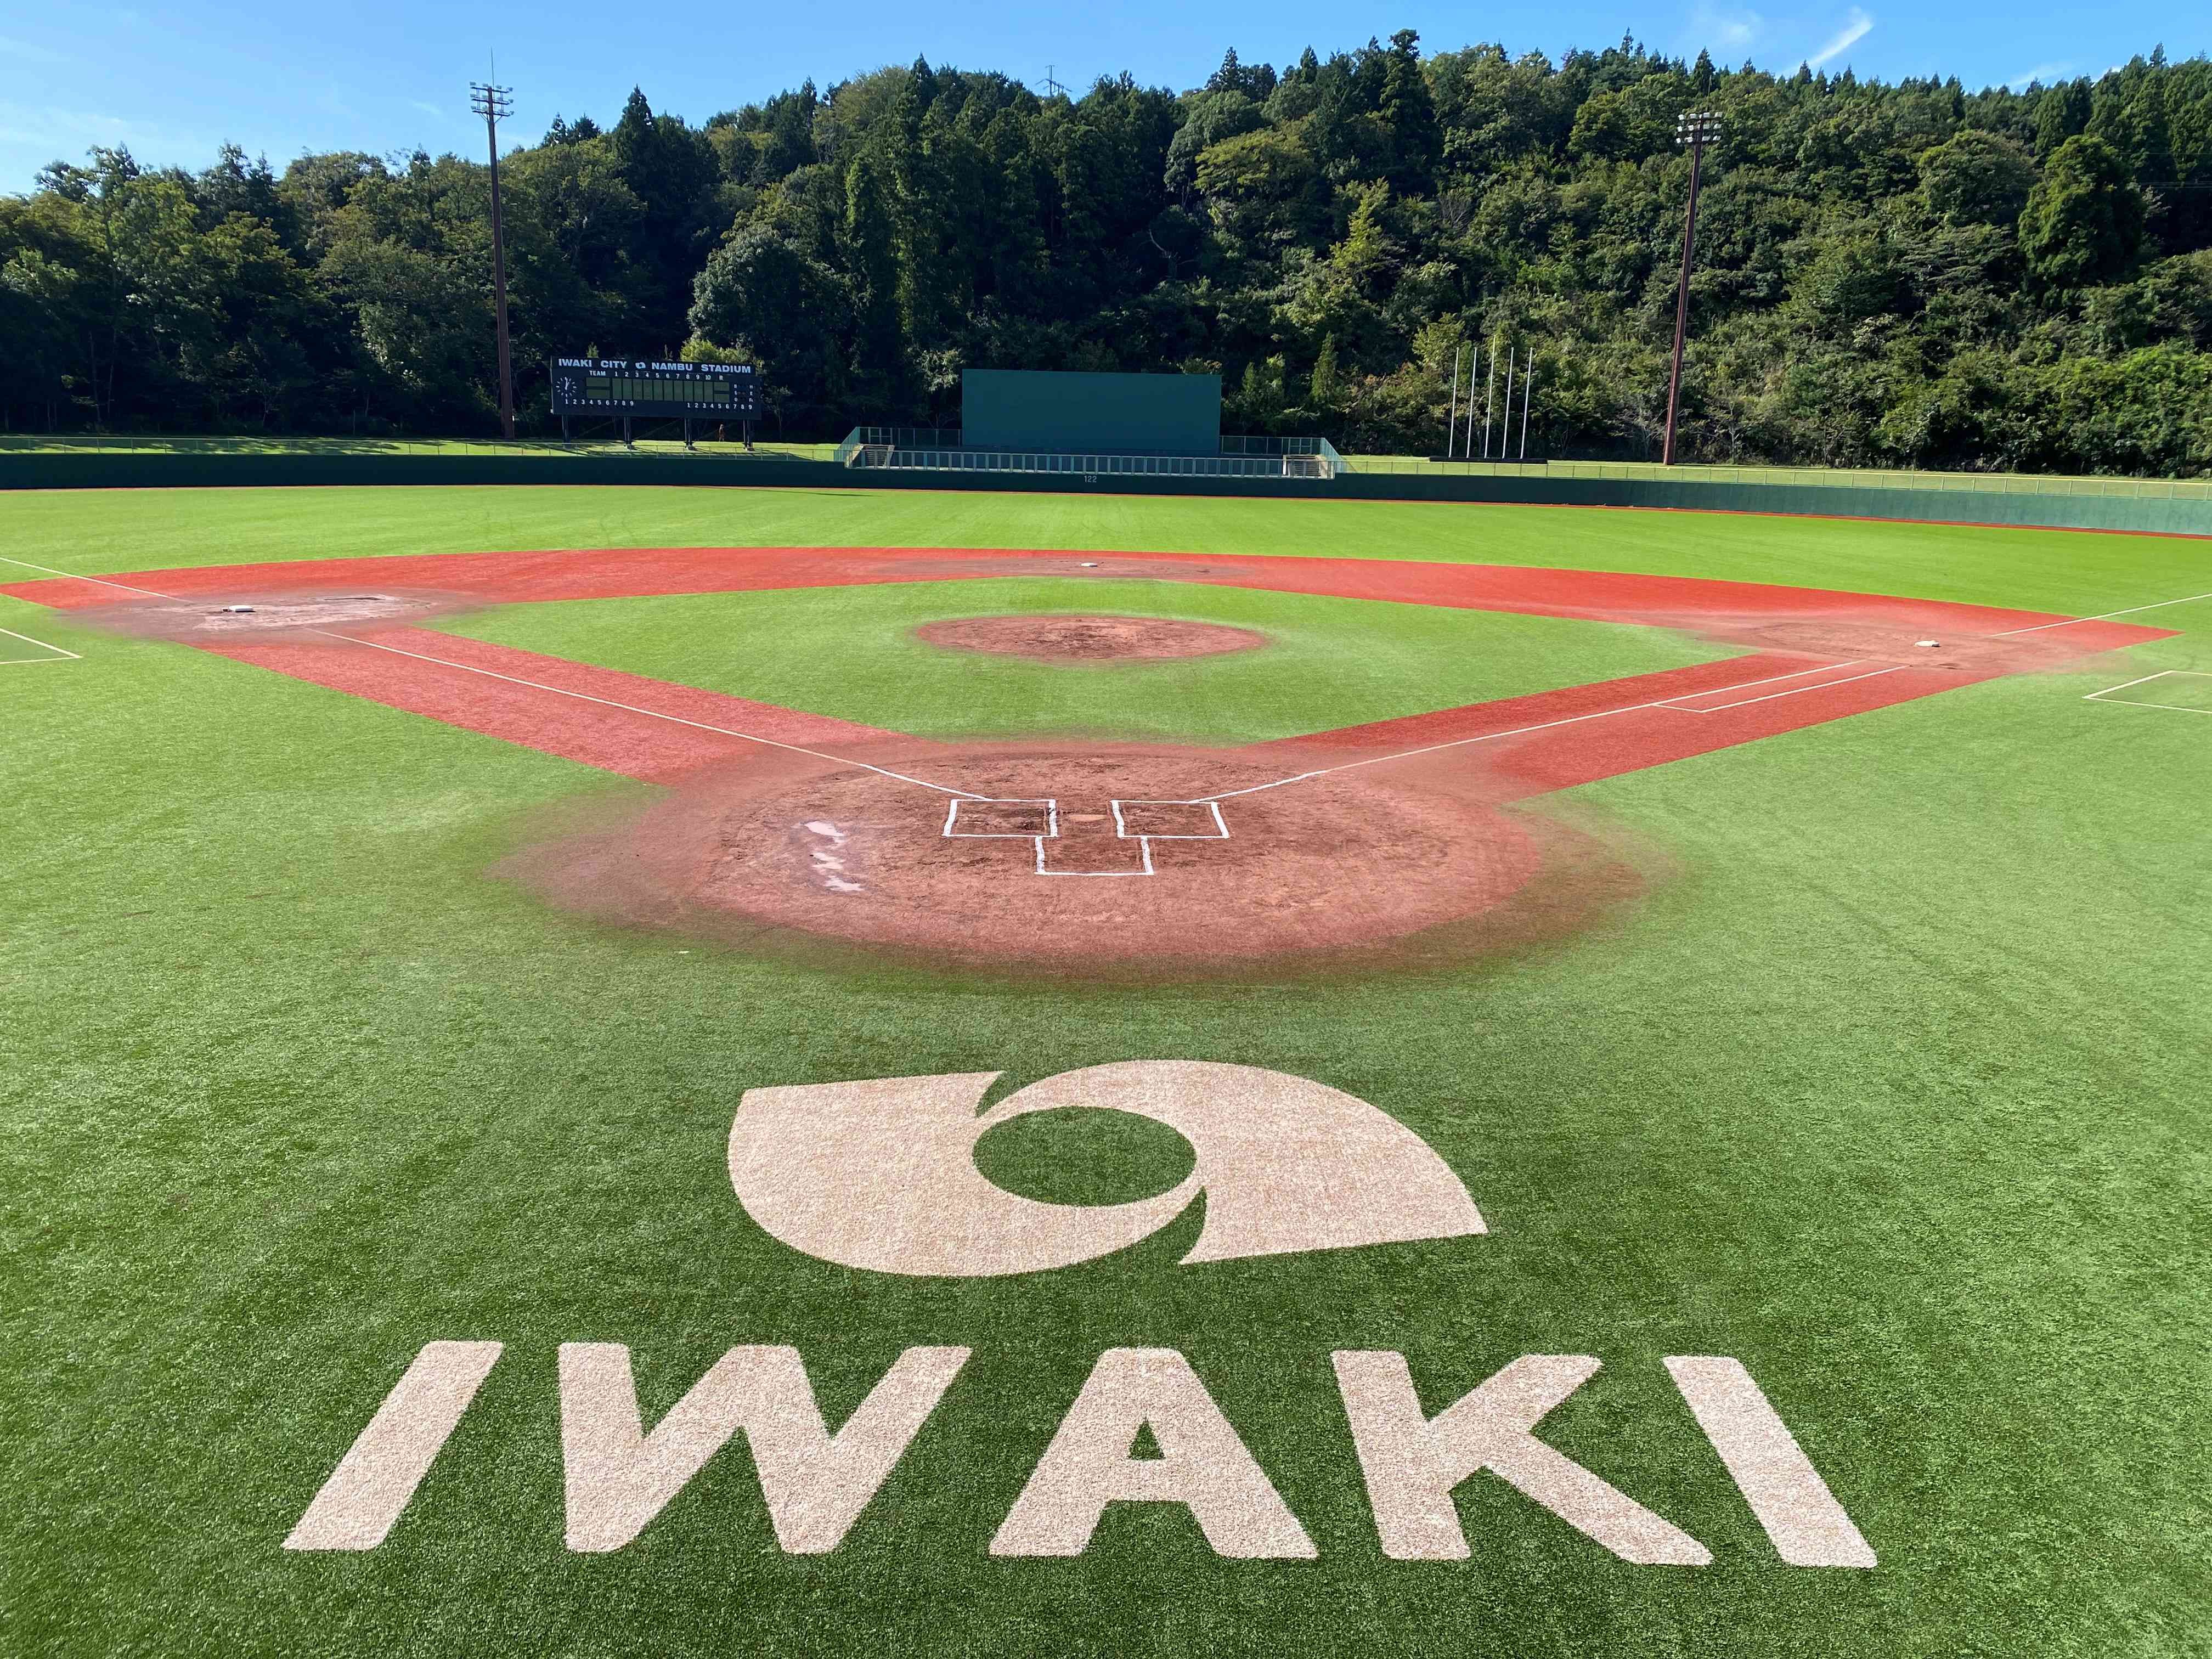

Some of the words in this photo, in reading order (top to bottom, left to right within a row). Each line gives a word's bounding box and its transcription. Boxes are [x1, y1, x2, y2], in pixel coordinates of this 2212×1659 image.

[558, 359, 592, 367] IWAKI
[600, 360, 627, 368] CITY
[701, 364, 751, 373] STADIUM
[281, 1340, 1876, 1570] IWAKI
